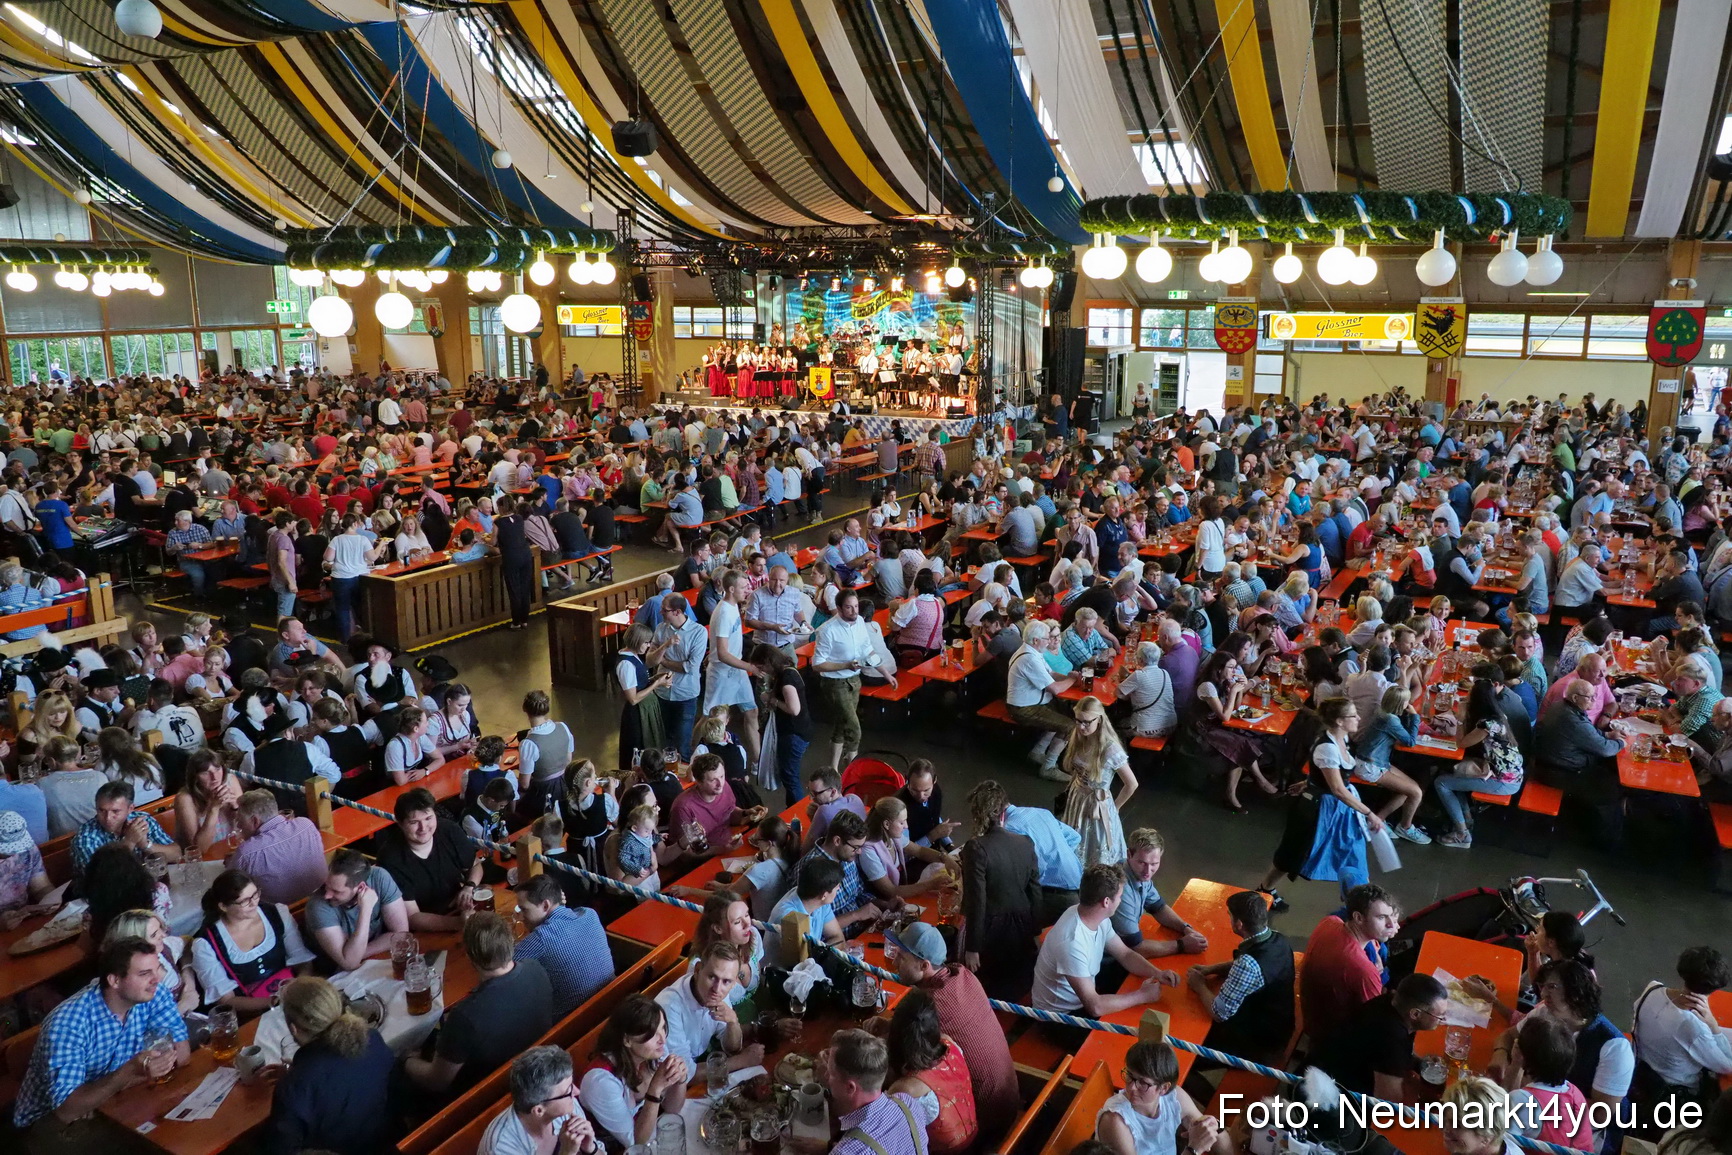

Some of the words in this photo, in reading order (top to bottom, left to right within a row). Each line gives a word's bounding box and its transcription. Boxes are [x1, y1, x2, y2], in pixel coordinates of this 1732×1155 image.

[583, 307, 609, 323] Glossner
[1316, 316, 1364, 337] Glossner
[1342, 329, 1364, 337] Bier
